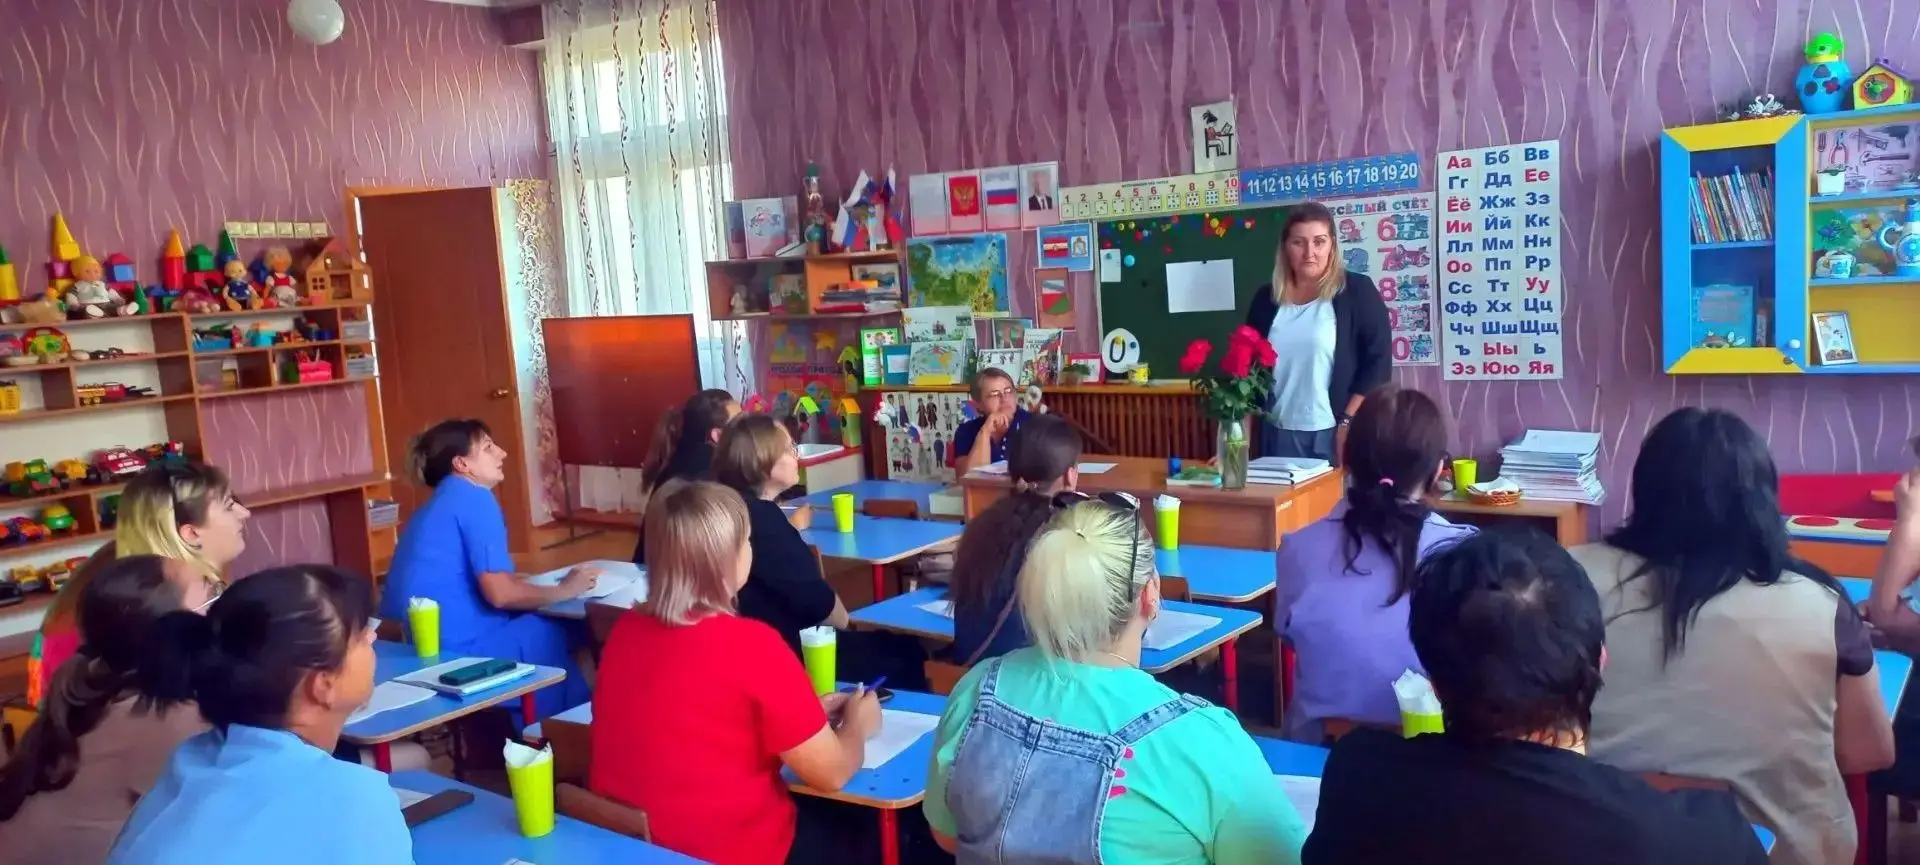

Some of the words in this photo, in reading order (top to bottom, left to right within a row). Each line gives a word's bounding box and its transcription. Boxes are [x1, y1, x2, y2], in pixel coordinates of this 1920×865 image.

[1447, 156, 1471, 169] Аа
[1485, 150, 1509, 165] Бб
[1525, 148, 1549, 161] Вв
[1248, 178, 1260, 194] 11
[1263, 178, 1276, 193] 12
[1278, 176, 1292, 191] 13
[1295, 174, 1309, 189] 14
[1311, 172, 1326, 187] 15
[1328, 170, 1343, 186] 16
[1346, 168, 1361, 184] 17
[1364, 166, 1379, 182] 18
[1382, 165, 1397, 181] 19
[1400, 162, 1417, 179] 20
[1449, 176, 1468, 189] Гг
[1485, 172, 1512, 189] Дд
[1525, 169, 1549, 182] Ее
[1065, 195, 1070, 203] 1
[1080, 193, 1086, 201] 2
[1098, 191, 1104, 200] 3
[1115, 190, 1121, 198] 4
[1133, 187, 1139, 196] 5
[1150, 186, 1157, 195] 6
[1169, 184, 1176, 193] 7
[1189, 182, 1195, 191] 8
[1208, 180, 1215, 189] 9
[1224, 178, 1238, 188] 10
[1330, 200, 1387, 215] ЕСЁЛЫЙ
[1392, 197, 1428, 210] СЧЁТ
[1447, 195, 1471, 212] Ёё
[1480, 195, 1515, 209] Жж
[1526, 192, 1550, 205] Зз
[1377, 216, 1396, 241] 6
[1447, 220, 1472, 233] Ии
[1485, 214, 1512, 231] Йй
[1525, 214, 1549, 227] Кк
[1447, 240, 1472, 253] Лл
[1483, 238, 1513, 250] Мм
[1524, 235, 1551, 248] Нн
[1377, 247, 1395, 271] 7
[1447, 260, 1472, 273] Оо
[1485, 258, 1511, 271] Пп
[1526, 256, 1550, 271] Рр
[1379, 277, 1397, 301] 8
[1449, 281, 1472, 294] Сс
[1487, 279, 1509, 292] Тт
[1526, 277, 1549, 293] Уу
[1445, 301, 1477, 317] Фф
[1487, 300, 1511, 312] Хх
[1524, 298, 1553, 313] Цц
[1450, 323, 1474, 335] Чч
[1482, 321, 1517, 334] Шш
[1520, 320, 1559, 335] Щщ
[1392, 336, 1410, 360] 0
[1455, 345, 1470, 355] Ъ
[1484, 342, 1517, 355] Ыы
[1534, 343, 1545, 354] Ь
[1452, 362, 1476, 375] Ээ
[1483, 362, 1520, 374] Юю
[1529, 361, 1553, 374] Яя
